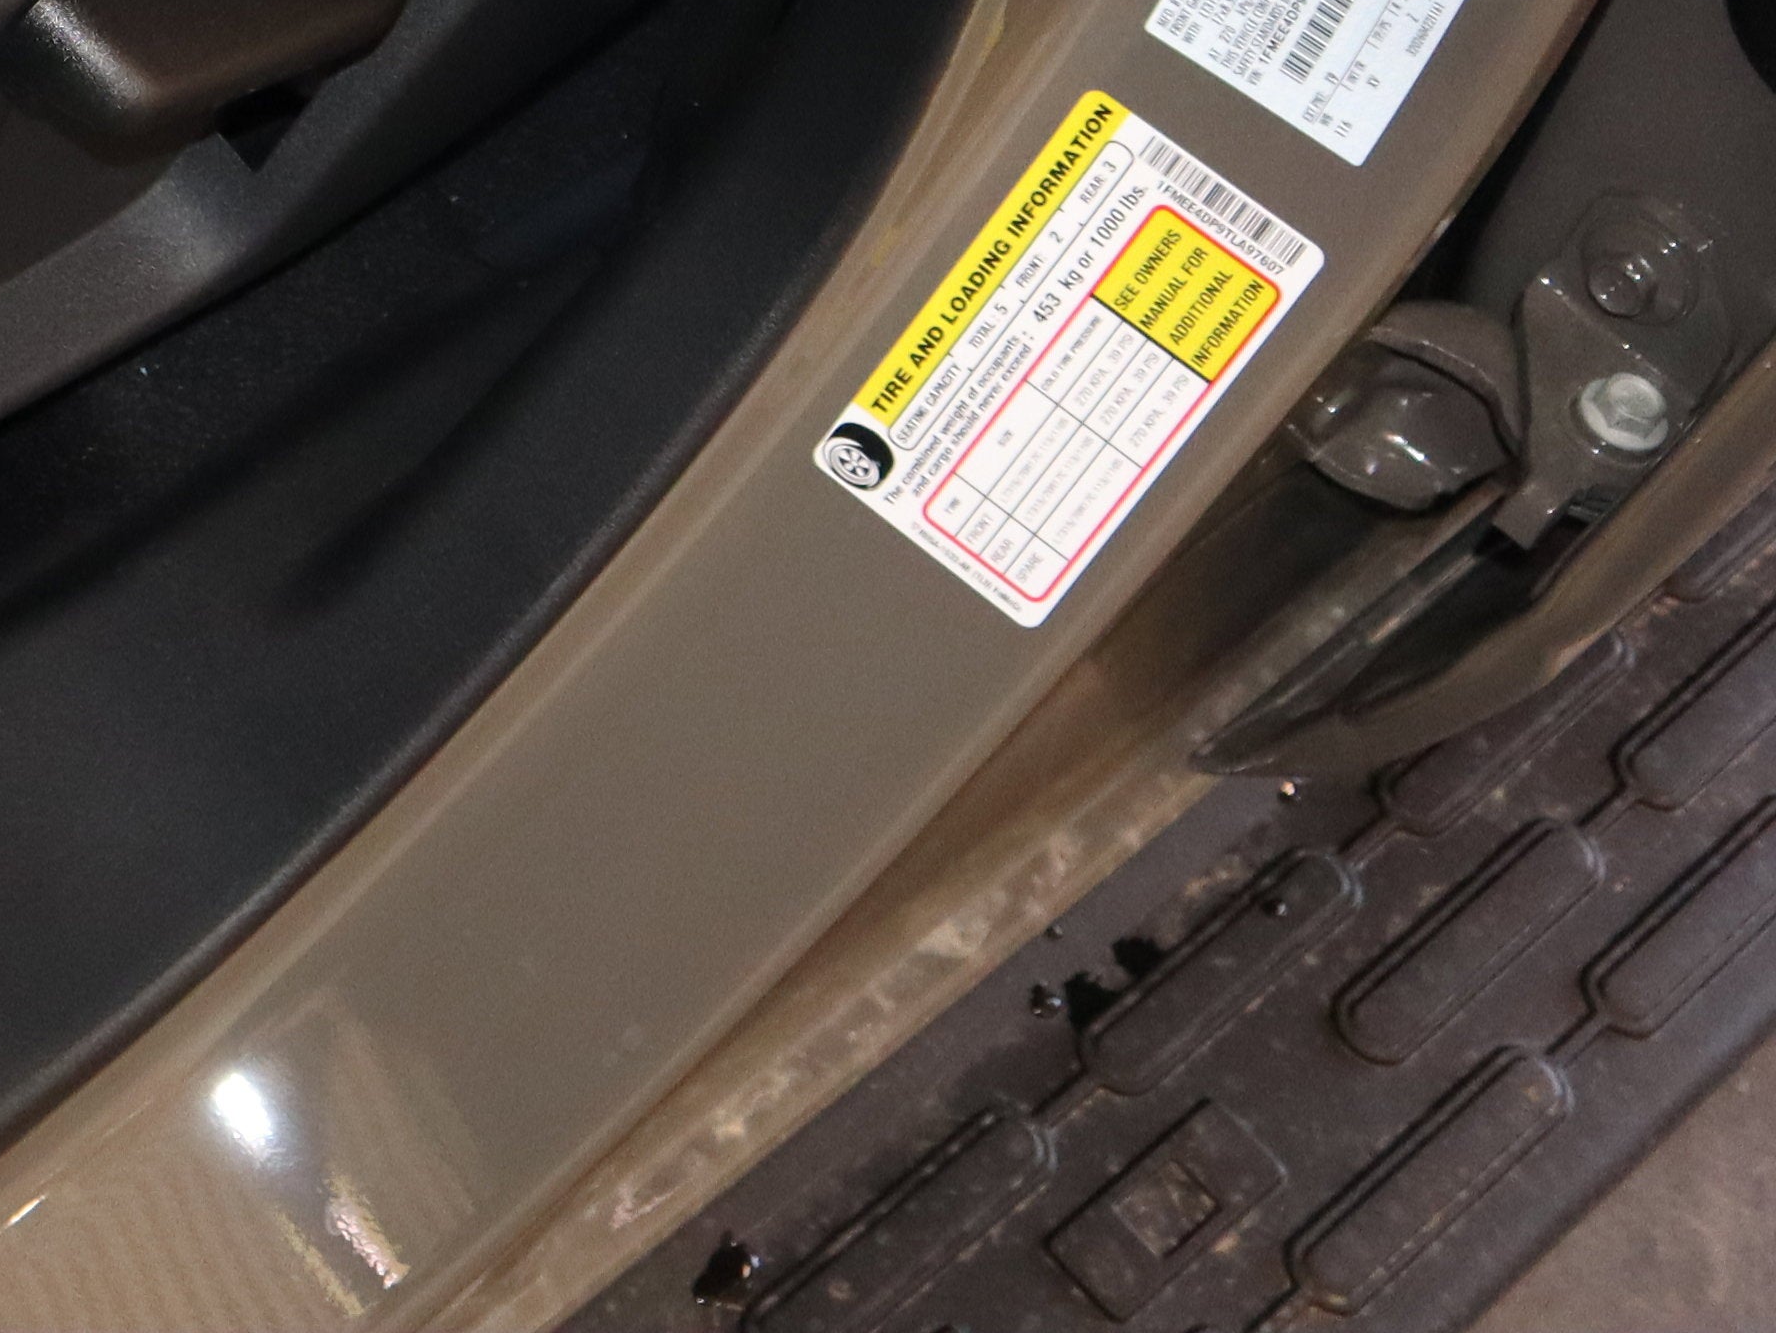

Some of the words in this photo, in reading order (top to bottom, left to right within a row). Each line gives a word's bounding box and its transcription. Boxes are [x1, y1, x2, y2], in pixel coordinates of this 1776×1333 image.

[1169, 7, 1191, 37] FRONT
[1232, 16, 1258, 52] VEHICLE
[1250, 0, 1286, 50] STANDARDS
[869, 365, 913, 416] TIRE
[905, 322, 947, 369] AND
[938, 236, 1013, 326] LOADING
[1003, 101, 1116, 238] INFORMATION
[1030, 290, 1062, 325] 453
[1057, 265, 1084, 292] kg
[1076, 248, 1095, 268] or
[1088, 206, 1127, 249] 1000
[1112, 282, 1140, 312] SEE
[1132, 227, 1182, 286] OWNERS
[1156, 179, 1285, 278] 1FMEE4DP9TLA97607
[895, 403, 930, 444] SEATING
[922, 361, 962, 407] CAPACITY
[993, 301, 1008, 315] 5
[1048, 229, 1064, 244] 2
[1101, 159, 1117, 173] 3
[1138, 273, 1188, 331] MANUAL
[1180, 245, 1209, 276] FOR
[1166, 265, 1234, 346] ADDITIONAL
[1190, 278, 1265, 369] INFORMATION
[883, 482, 905, 506] The
[898, 434, 943, 486] combined
[937, 398, 973, 439] weight
[964, 385, 980, 401] of
[974, 332, 1024, 391] occupants
[910, 475, 931, 498] and
[927, 446, 956, 479] cargo
[949, 410, 981, 447] should
[977, 381, 1004, 412] never
[998, 342, 1033, 383] exceed
[965, 512, 994, 546] FRONT
[1073, 384, 1093, 406] 270
[1105, 347, 1122, 363] 39
[1115, 330, 1134, 350] PSI
[990, 536, 1015, 565] REAR
[1098, 403, 1119, 426] 270
[1130, 366, 1148, 383] 39
[1141, 350, 1160, 369] PSI
[1014, 551, 1044, 585] SPARE
[1128, 425, 1149, 448] 270
[1161, 388, 1178, 405] 39
[1171, 372, 1191, 392] PSI
